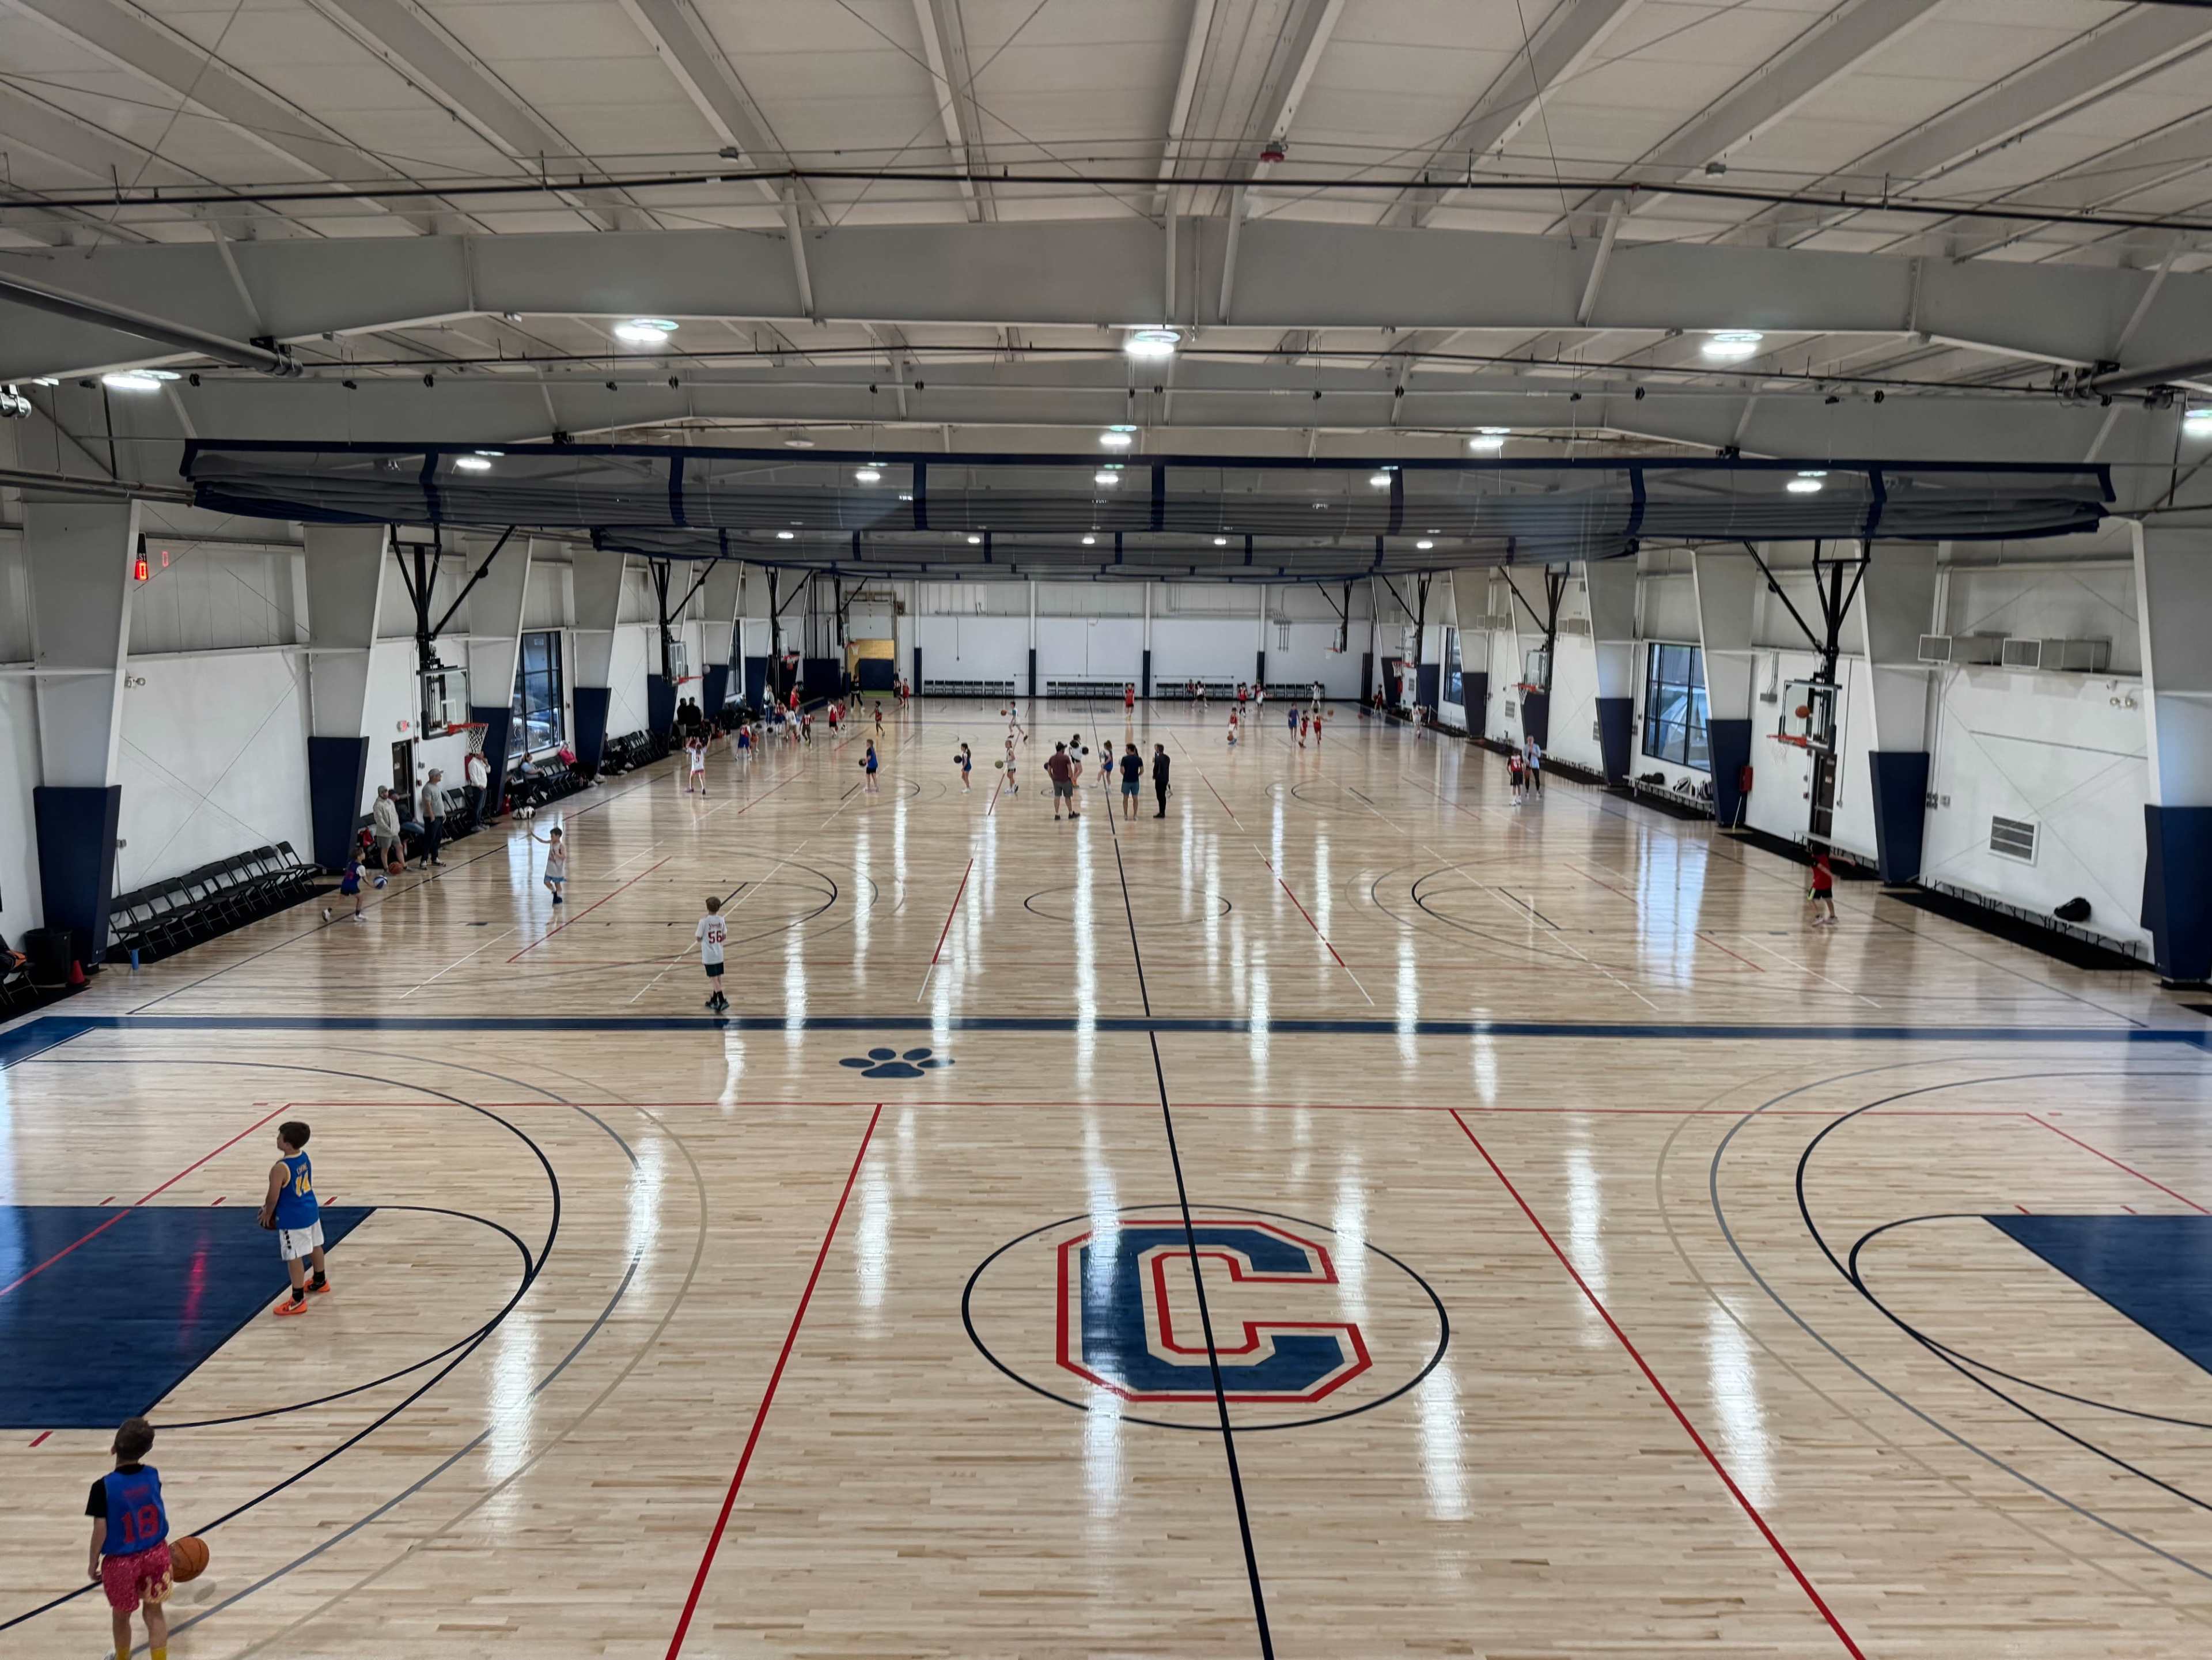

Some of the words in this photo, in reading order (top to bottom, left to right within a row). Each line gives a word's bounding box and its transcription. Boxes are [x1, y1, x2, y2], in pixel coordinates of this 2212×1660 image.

[708, 930, 722, 944] 56
[296, 1170, 311, 1197] 14
[1056, 1219, 1373, 1402] C
[120, 1503, 160, 1544] 18
